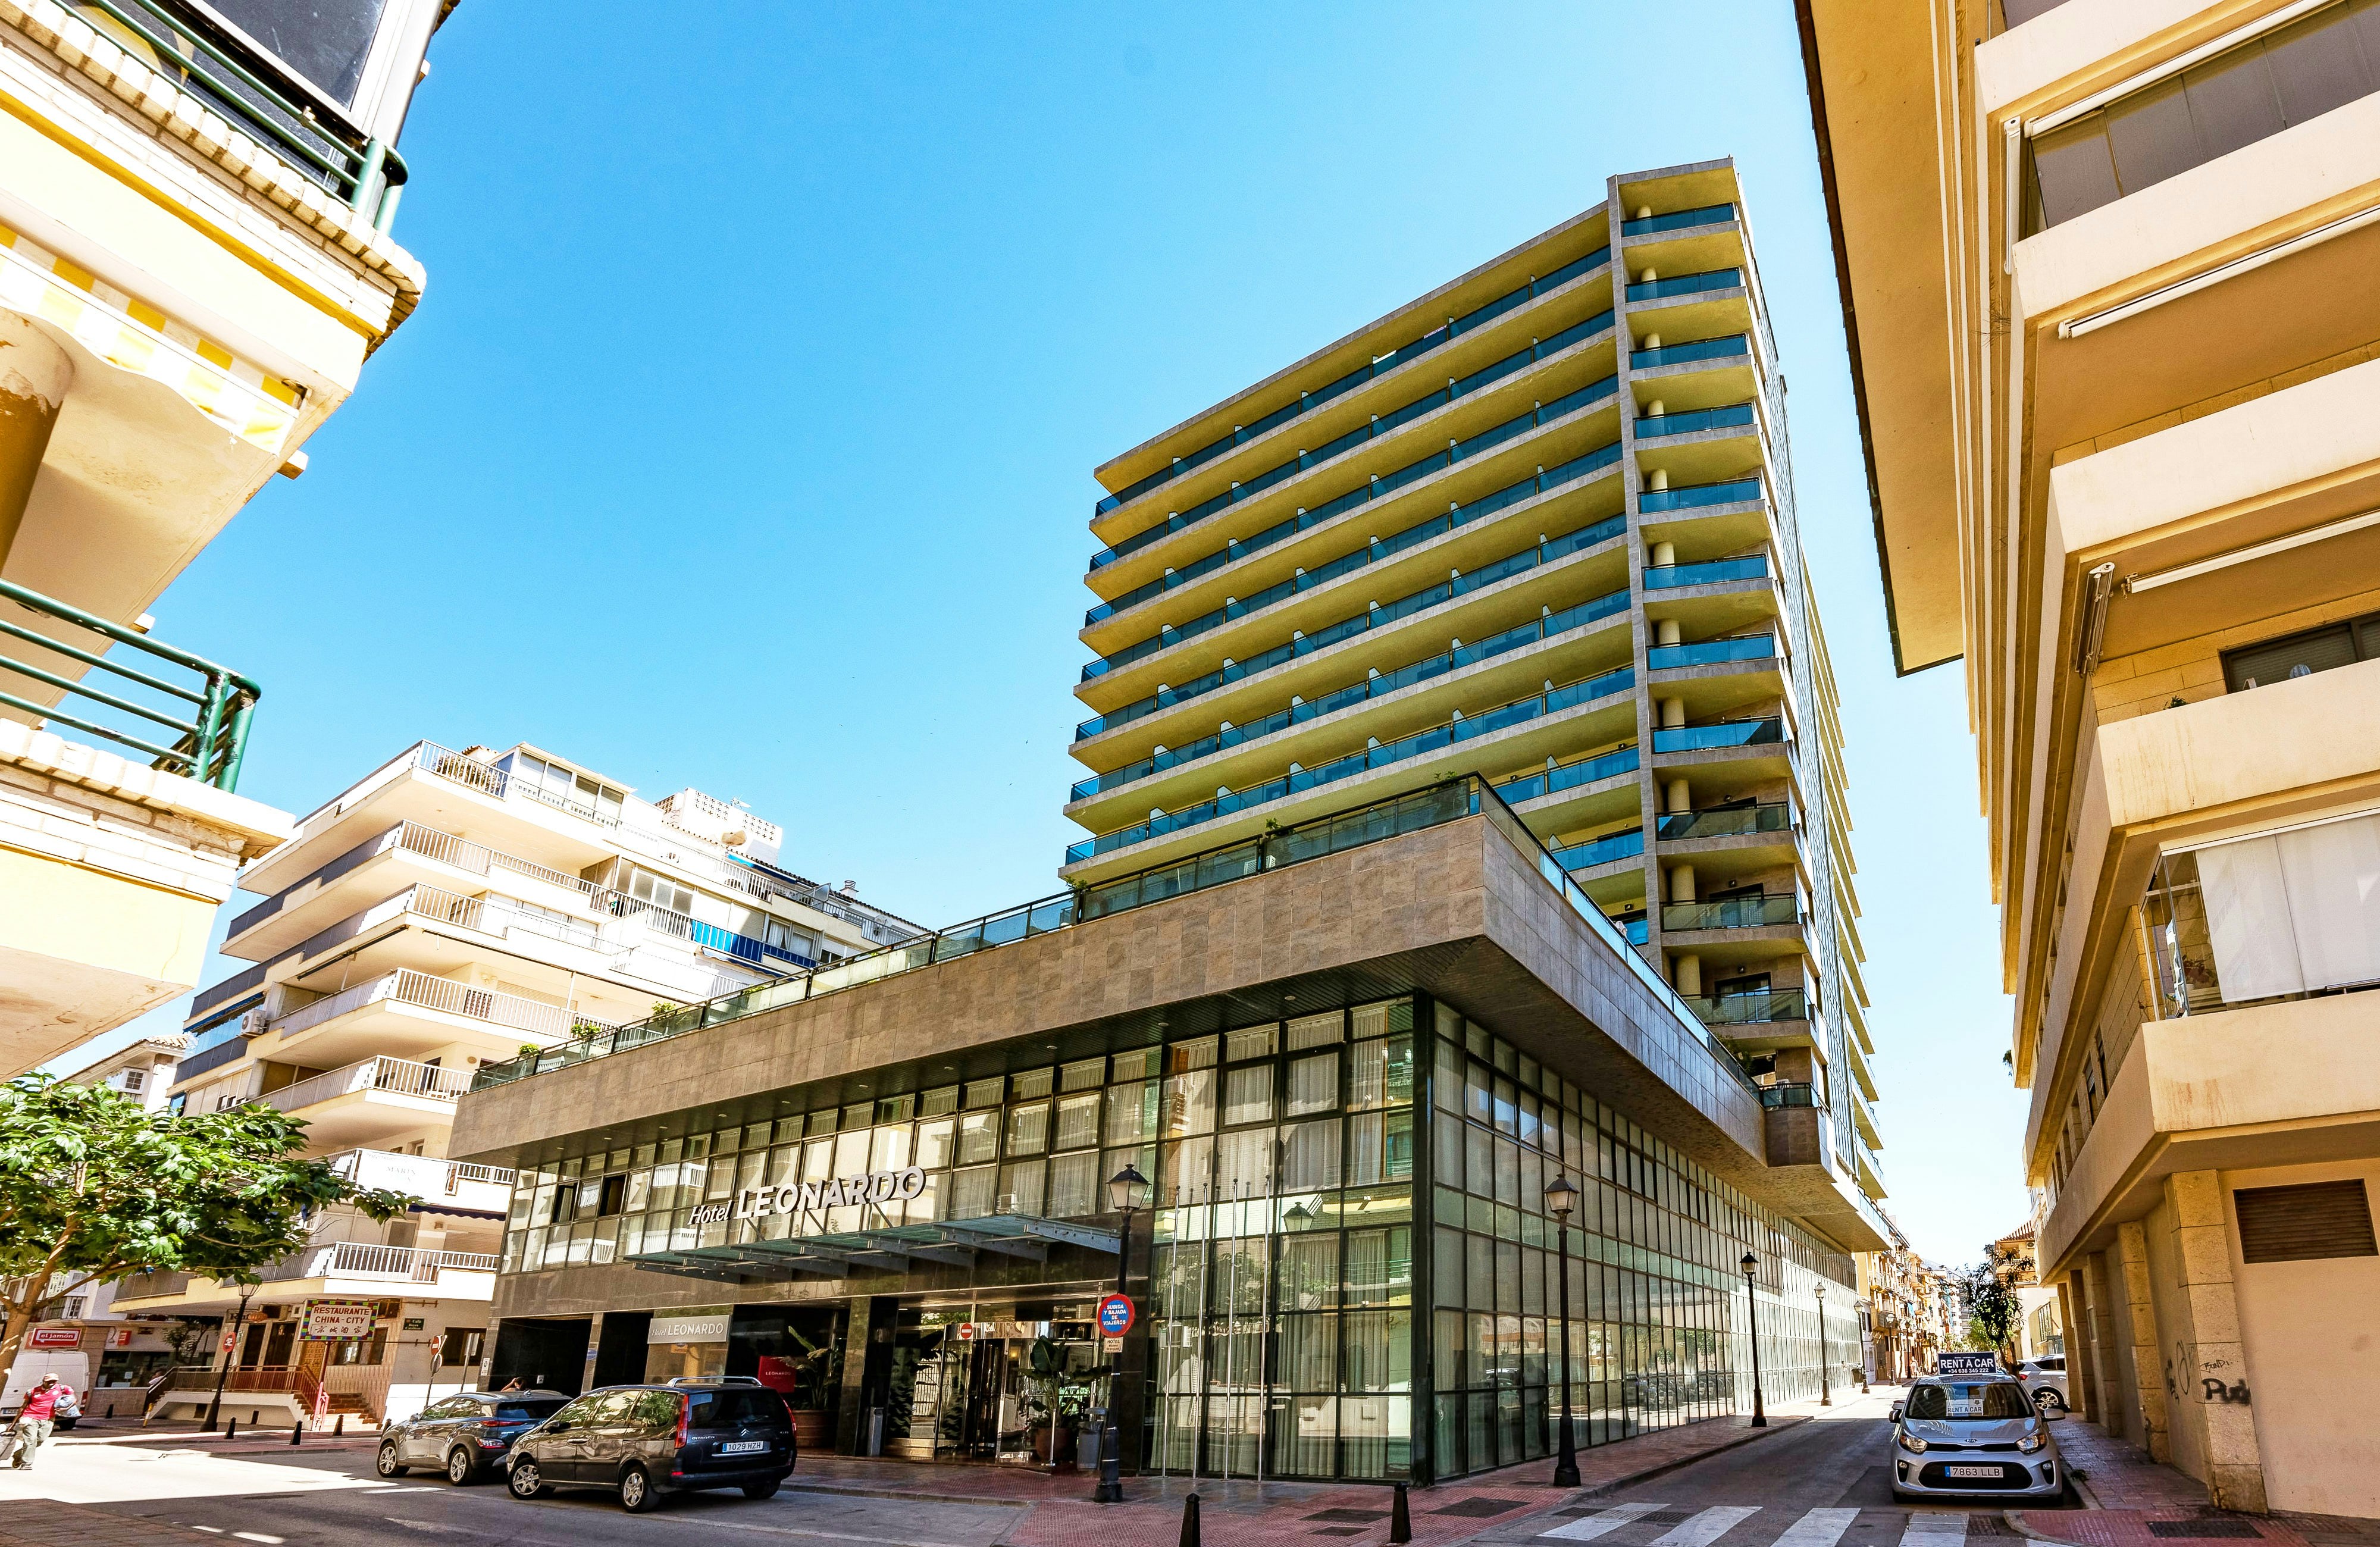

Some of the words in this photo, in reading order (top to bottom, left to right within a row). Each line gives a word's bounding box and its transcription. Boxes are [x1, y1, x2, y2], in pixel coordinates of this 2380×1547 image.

[687, 1200, 734, 1225] Hotel
[734, 1166, 926, 1219] LEONARDO
[314, 1307, 369, 1316] RESTAURANTE
[668, 1323, 724, 1336] LEONARDO
[1940, 1359, 1964, 1368] RENT
[1966, 1359, 1973, 1368] A
[1974, 1358, 1994, 1368] CAR
[1981, 1468, 2000, 1476] LLB
